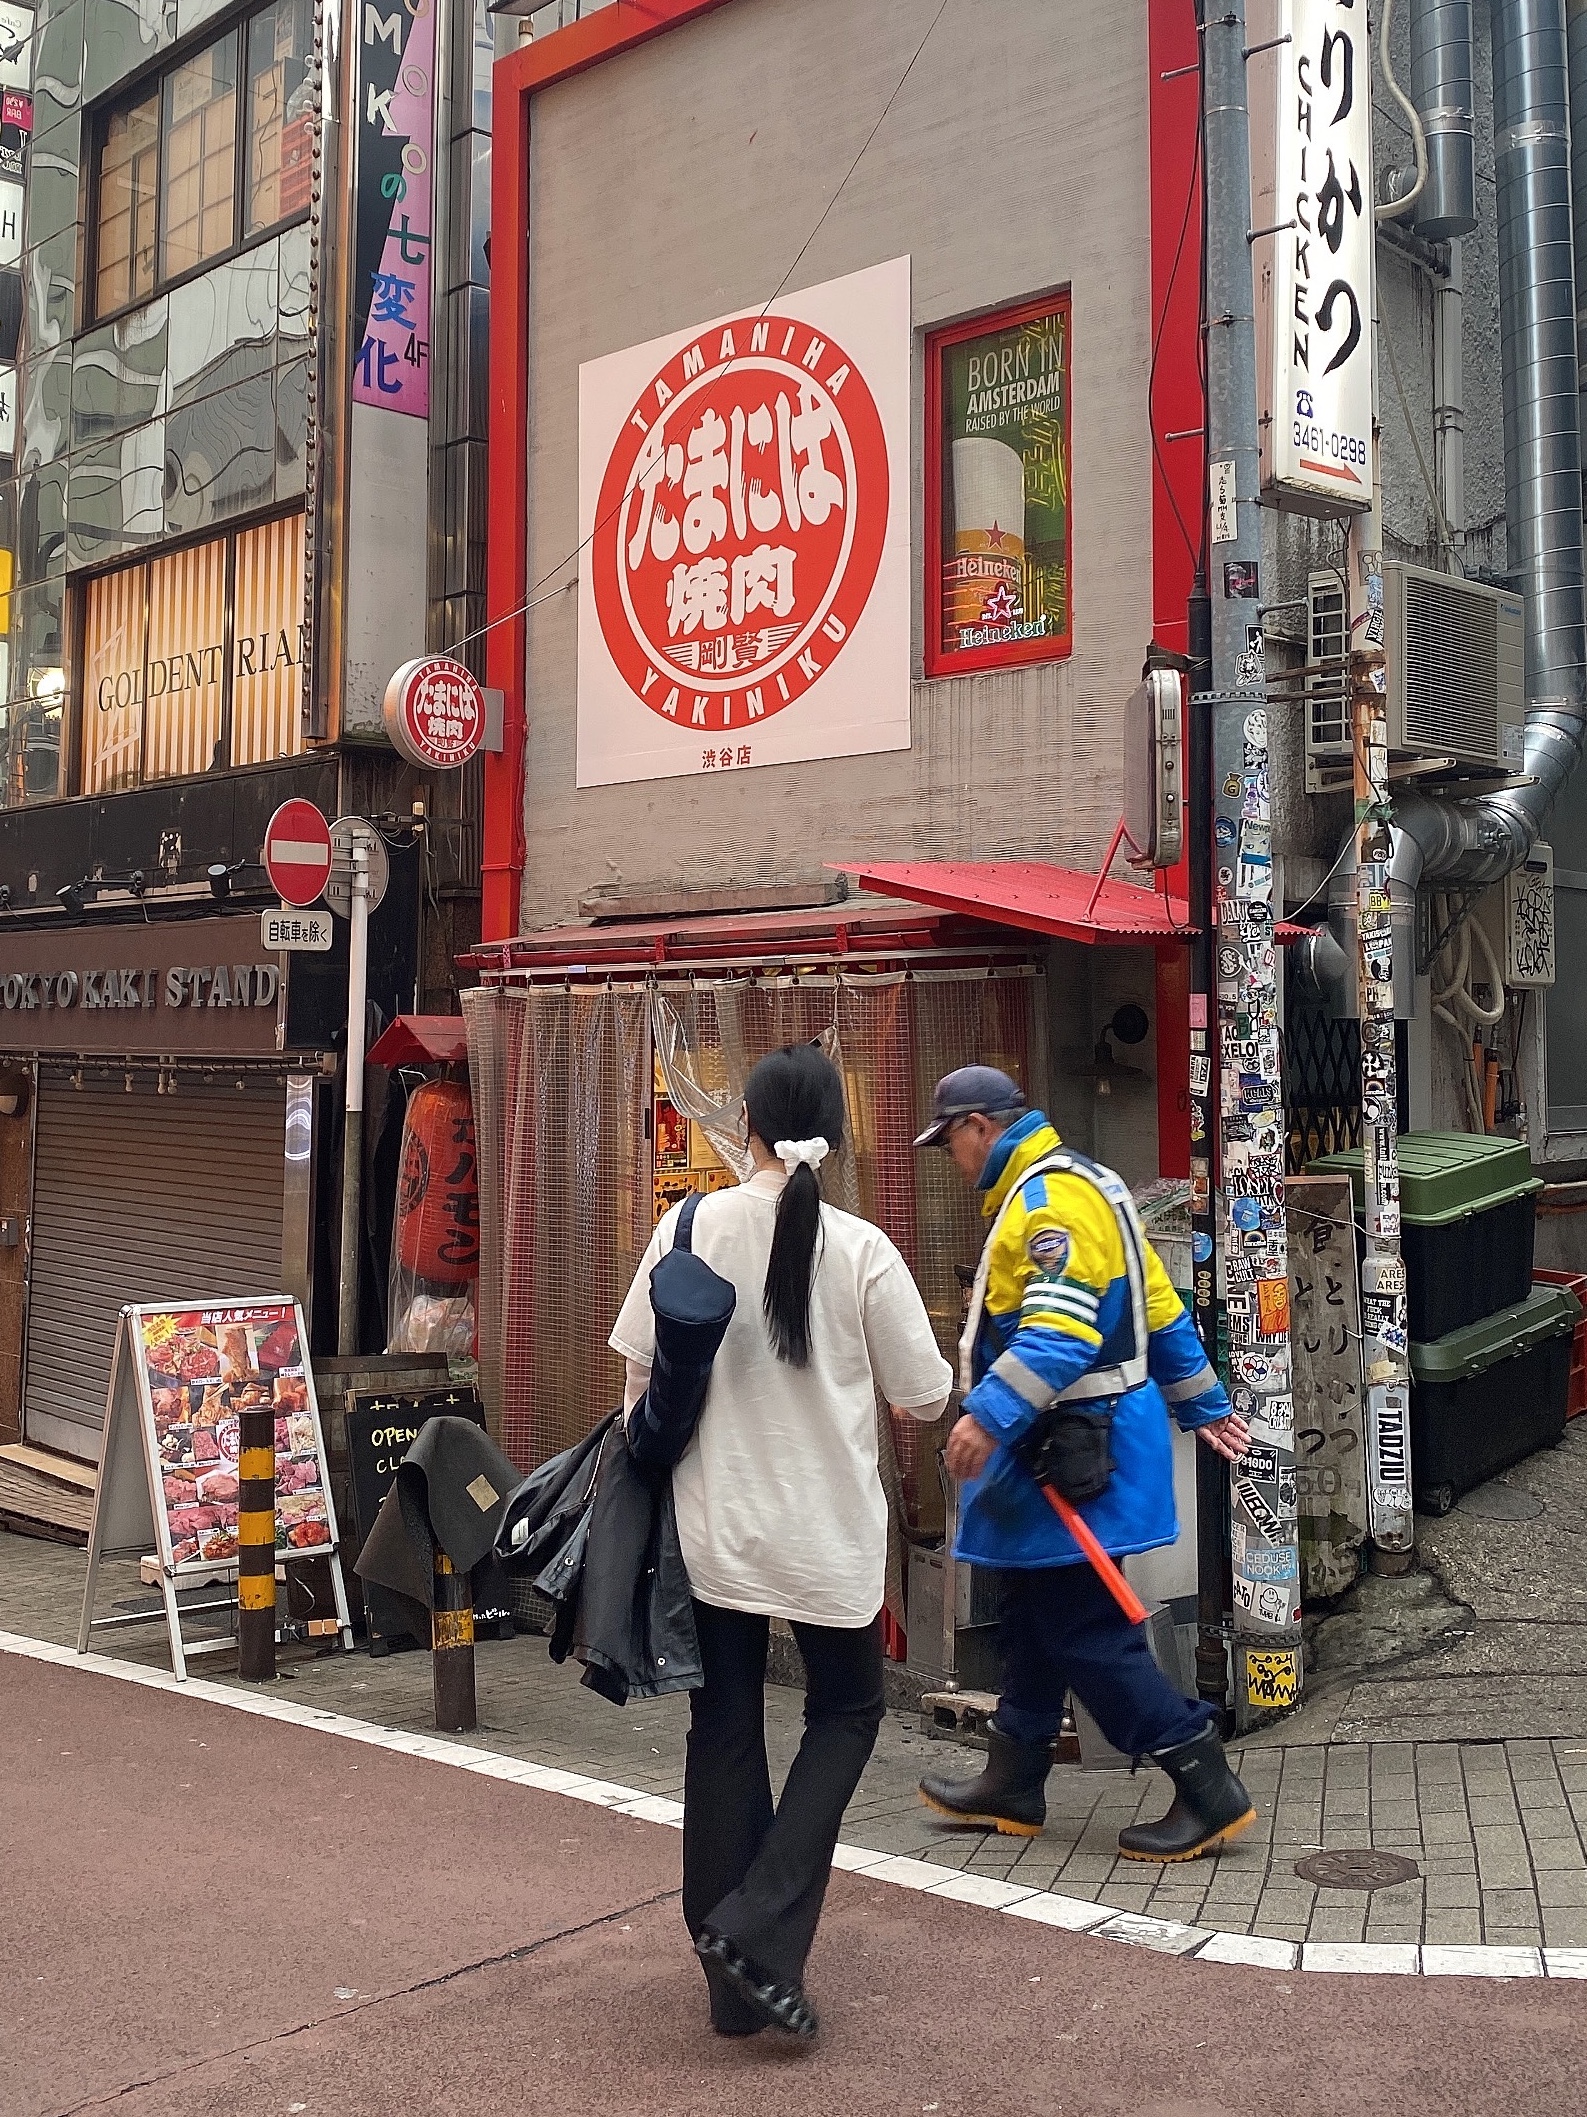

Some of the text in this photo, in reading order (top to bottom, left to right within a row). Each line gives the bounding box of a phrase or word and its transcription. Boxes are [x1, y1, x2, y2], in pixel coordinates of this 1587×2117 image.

[1293, 54, 1314, 375] CHICKEN
[403, 332, 429, 369] 4F
[967, 332, 1063, 392] BORN IN
[630, 321, 852, 434] TAMANIHA
[966, 371, 1061, 415] AMSTERDAM
[965, 395, 1061, 433] RAISED BY THE WORLD
[1293, 420, 1366, 465] 3461-0298
[627, 381, 845, 572] たまには
[956, 556, 1022, 581] Heineken
[665, 543, 797, 638] 焼肉
[959, 617, 1046, 649] Heineken
[640, 612, 850, 728] YAKINIKU
[428, 716, 464, 739] 焼肉
[701, 744, 752, 769] 渋谷店
[1227, 783, 1237, 794] G
[268, 920, 328, 942] 自転車を除く
[0, 963, 279, 1009] OKYO KAKI STAND
[1232, 1257, 1252, 1272] RAW
[1234, 1269, 1255, 1283] CULT
[1376, 1280, 1405, 1291] ARES
[371, 1427, 418, 1446] OPEN
[1377, 1410, 1406, 1481] TADZIU
[1247, 1564, 1280, 1575] NOOK
